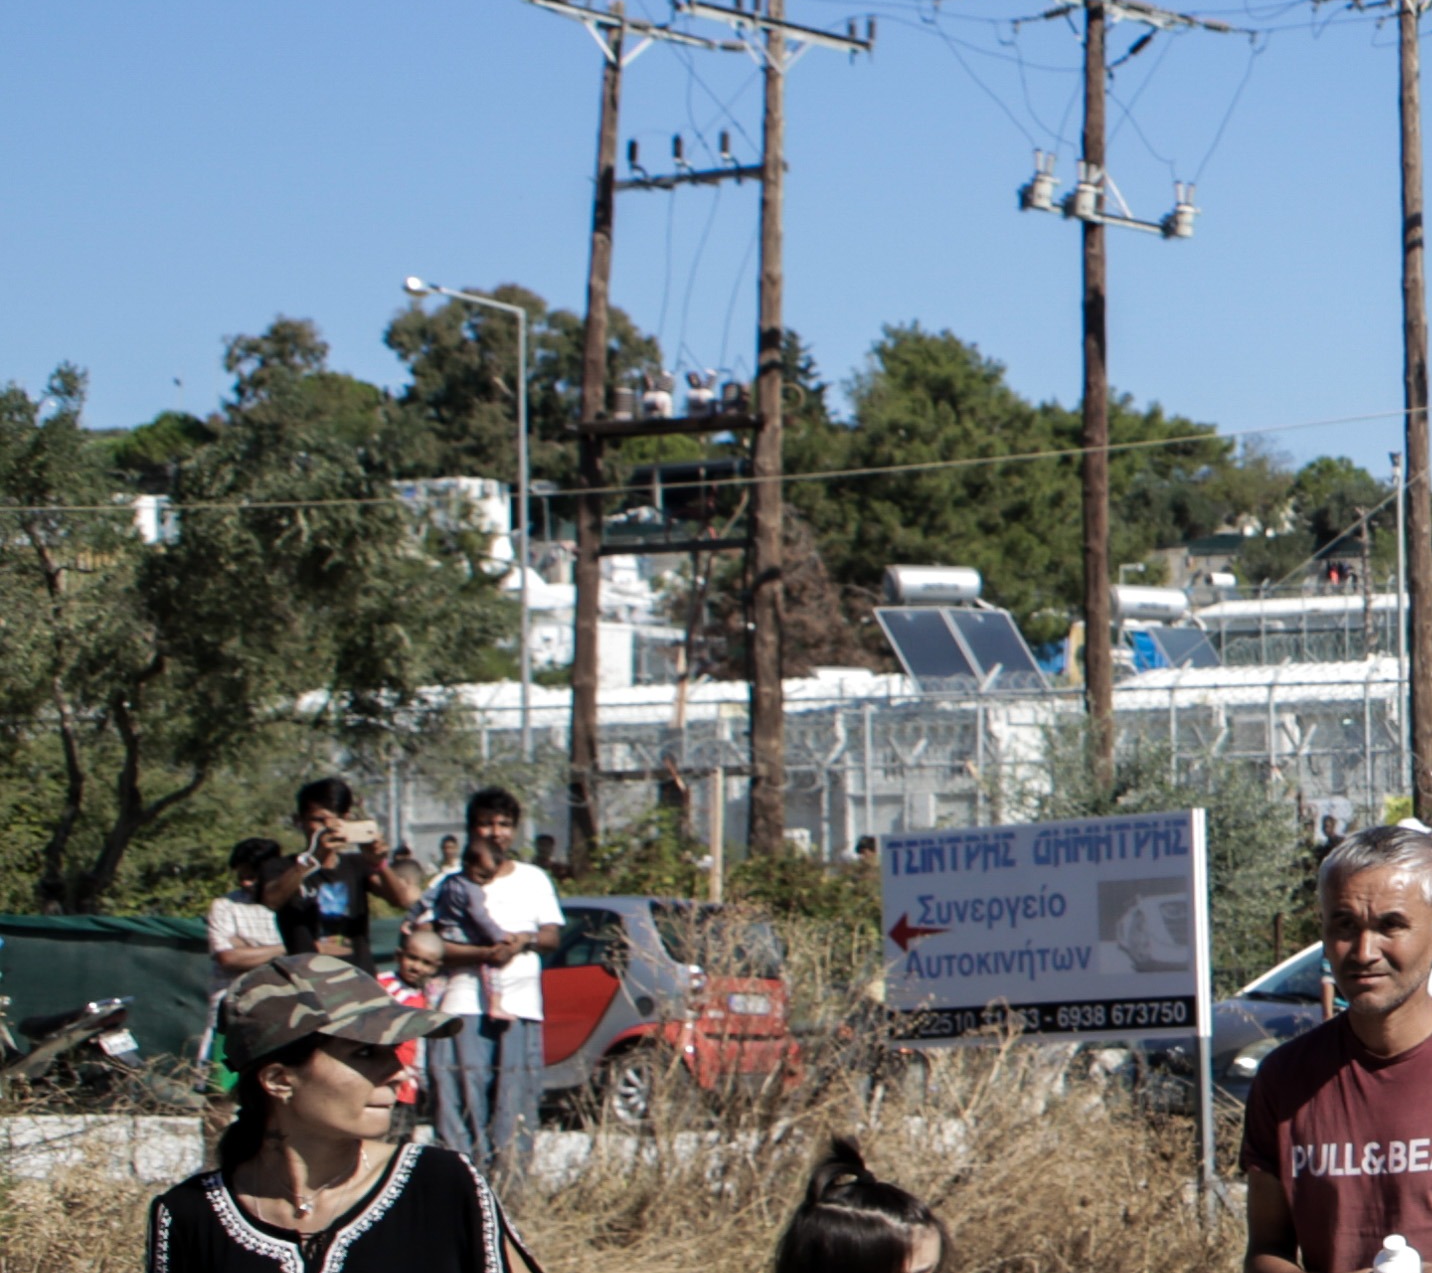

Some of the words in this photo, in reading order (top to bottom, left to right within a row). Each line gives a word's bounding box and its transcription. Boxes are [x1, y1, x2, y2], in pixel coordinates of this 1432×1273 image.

[916, 884, 1067, 930] Συνεργείο
[904, 939, 1092, 982] Αυτοκινήτων
[1056, 1004, 1106, 1028] 6938
[1111, 1001, 1187, 1025] 673750
